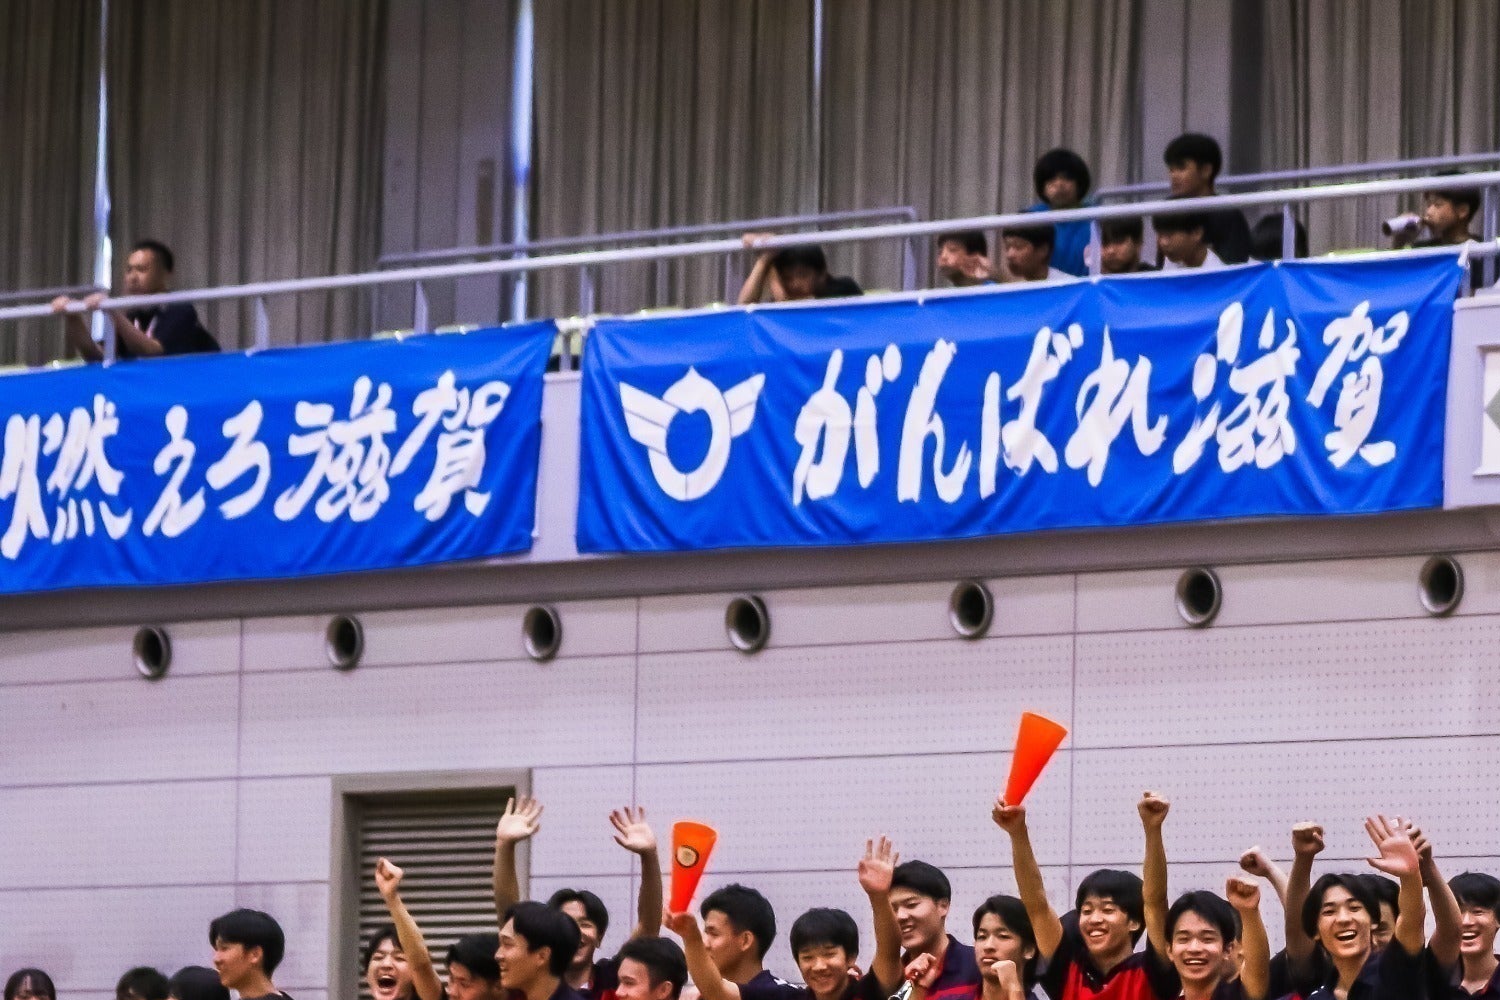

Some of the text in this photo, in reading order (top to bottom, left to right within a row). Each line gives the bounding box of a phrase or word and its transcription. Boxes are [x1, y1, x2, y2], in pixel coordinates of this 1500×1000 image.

[0, 370, 512, 560] 燃えろ滋賀
[792, 300, 1410, 506] がんばれ滋賀
